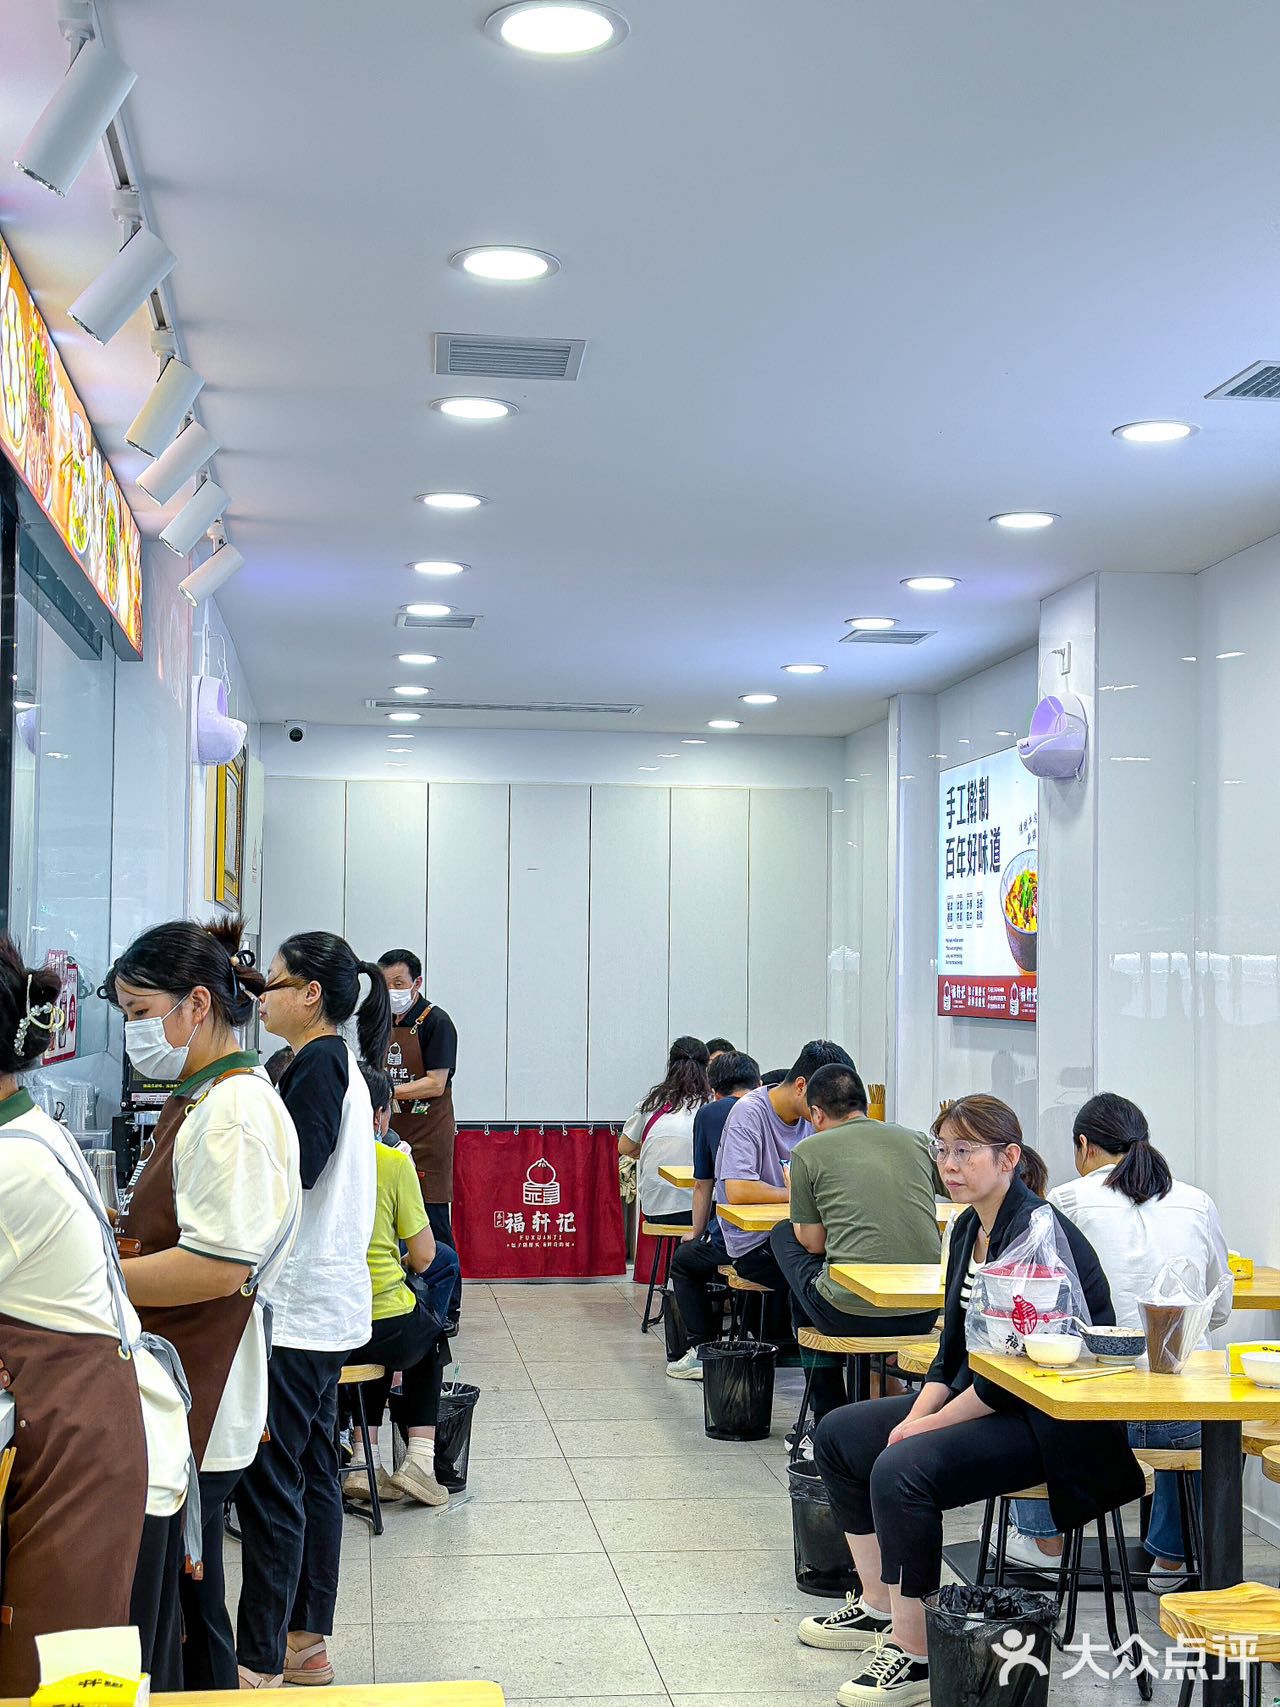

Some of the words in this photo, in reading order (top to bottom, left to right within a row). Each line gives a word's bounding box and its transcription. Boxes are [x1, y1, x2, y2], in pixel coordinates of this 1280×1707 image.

[946, 826, 1001, 880] 百年好味道
[504, 1211, 576, 1234] 福轩记
